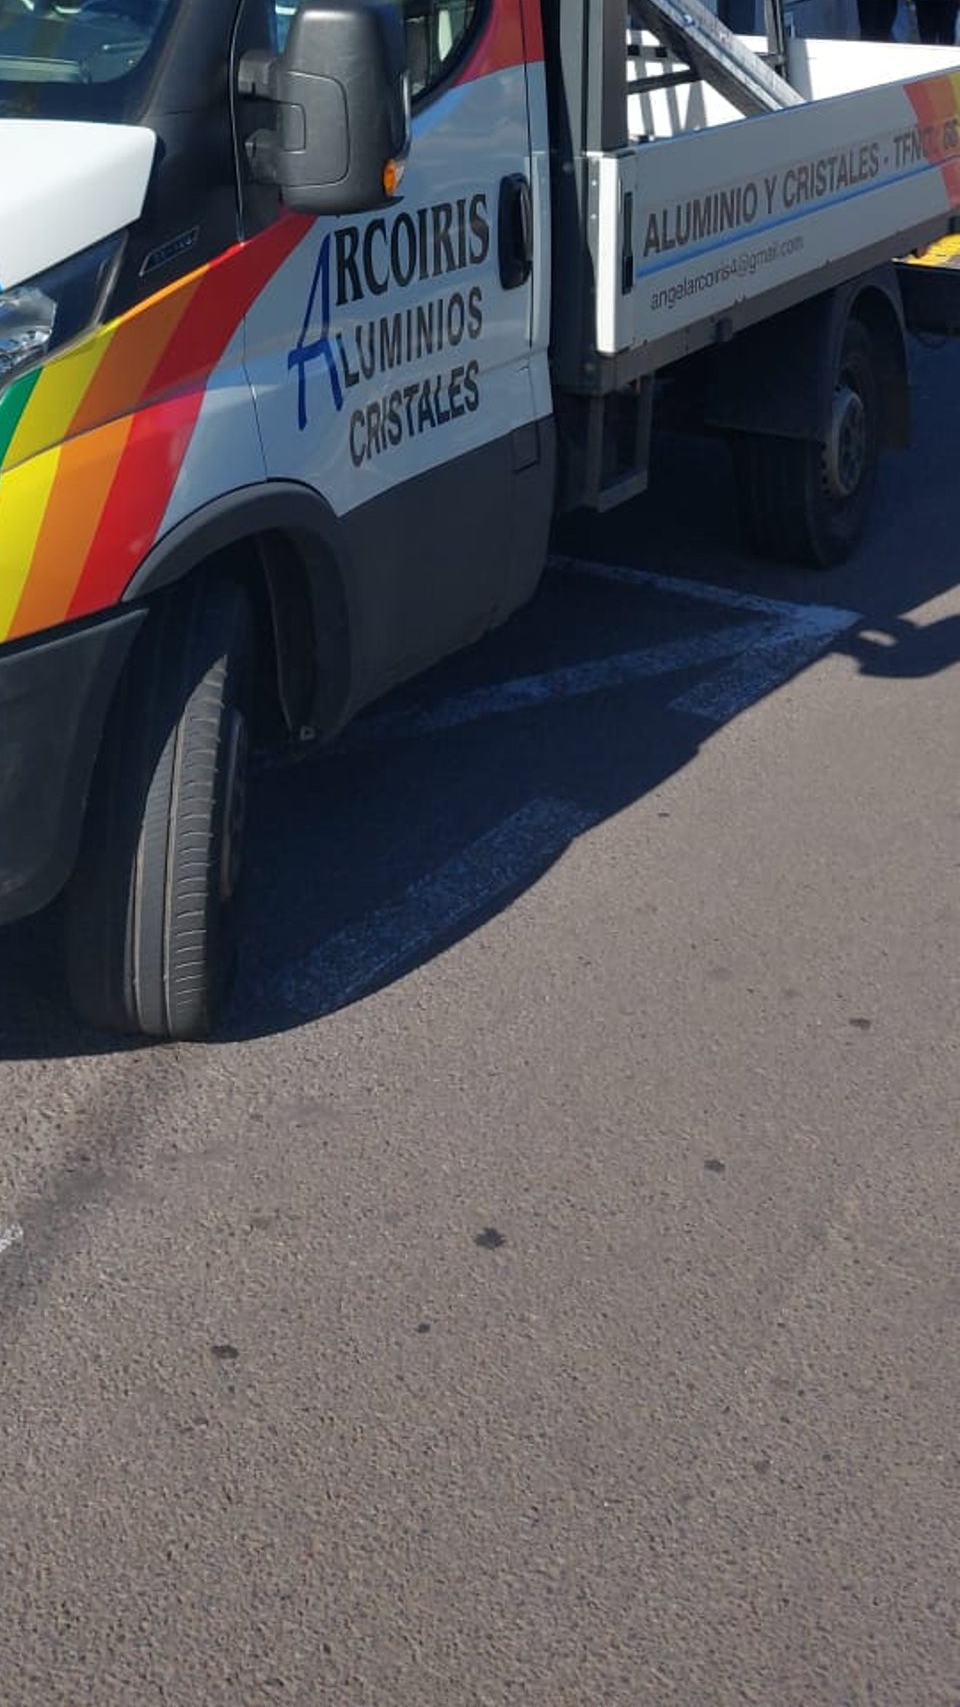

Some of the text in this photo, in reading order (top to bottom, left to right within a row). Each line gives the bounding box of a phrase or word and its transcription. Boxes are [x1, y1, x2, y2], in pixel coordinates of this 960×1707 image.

[643, 182, 758, 257] ALUMINIO
[764, 175, 778, 214] Y
[783, 142, 879, 209] CRISTALES
[348, 359, 480, 468] CRISTALES
